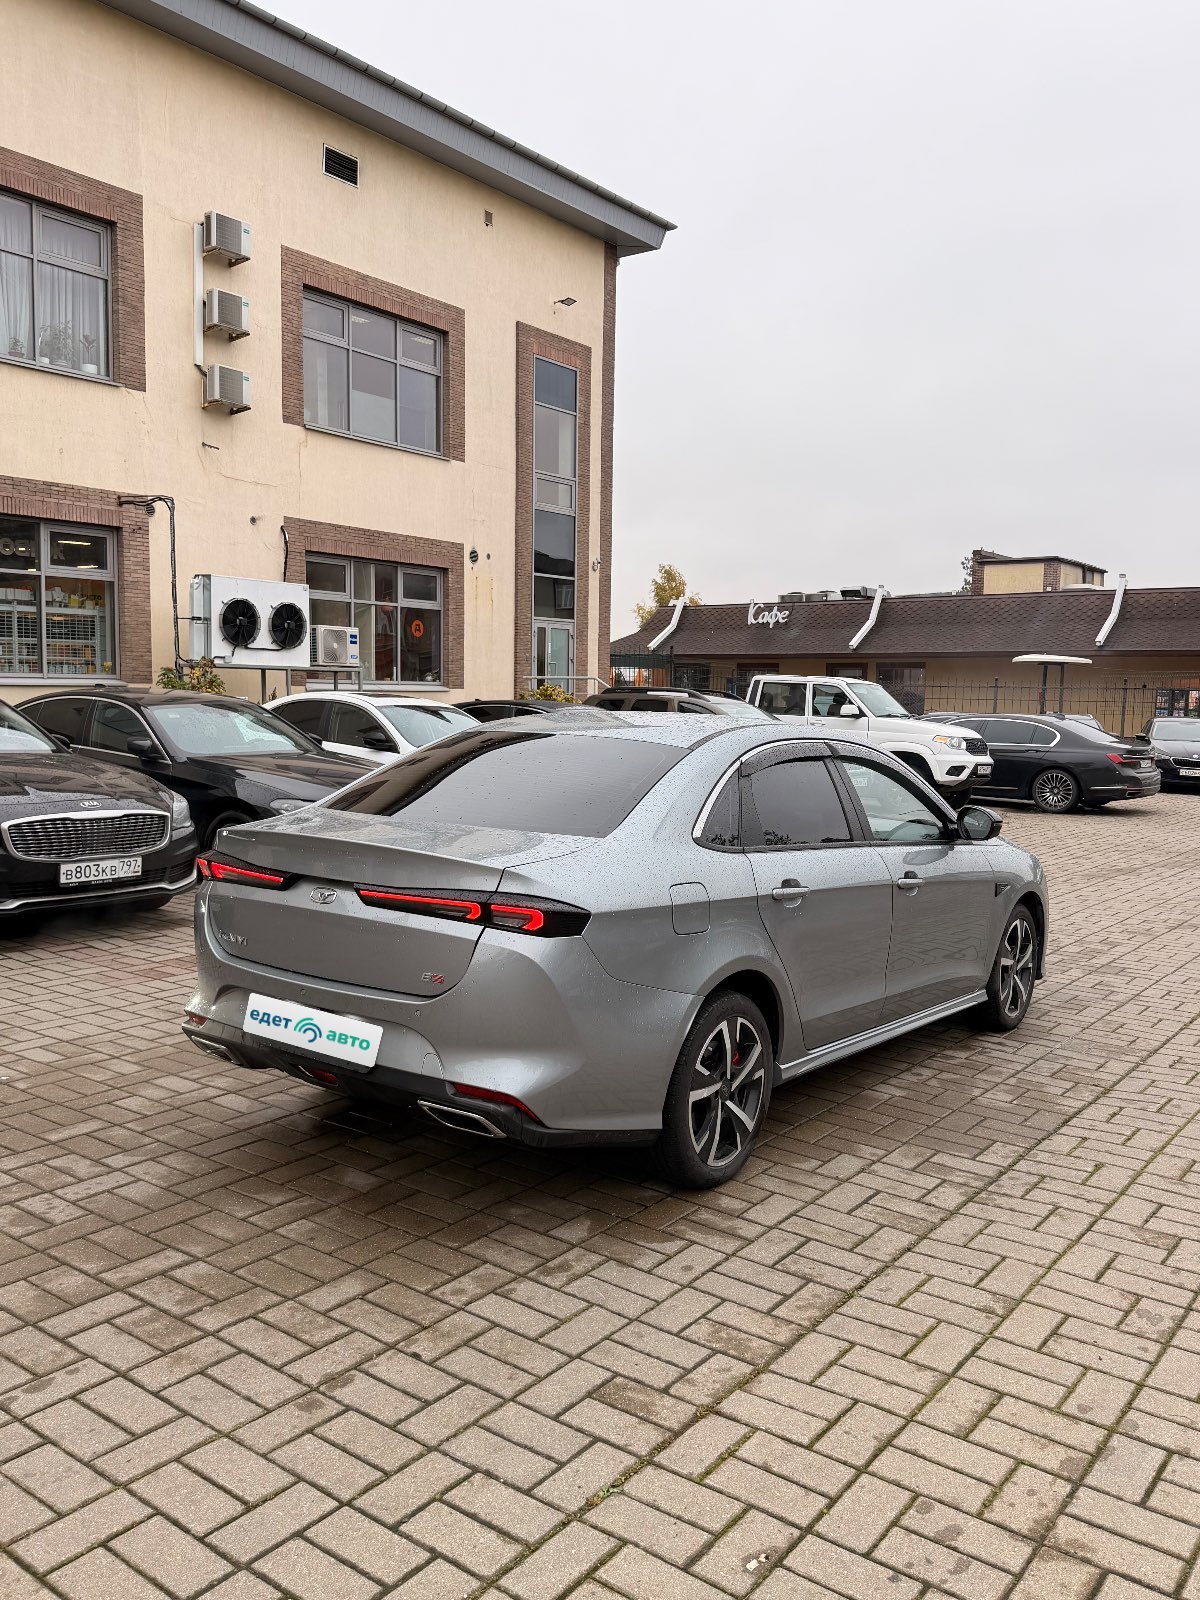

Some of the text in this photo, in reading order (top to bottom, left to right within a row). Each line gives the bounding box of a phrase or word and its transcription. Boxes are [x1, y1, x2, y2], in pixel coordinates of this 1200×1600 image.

[747, 599, 789, 628] Кафе
[120, 859, 138, 872] 797
[249, 1008, 371, 1051] едет авто
